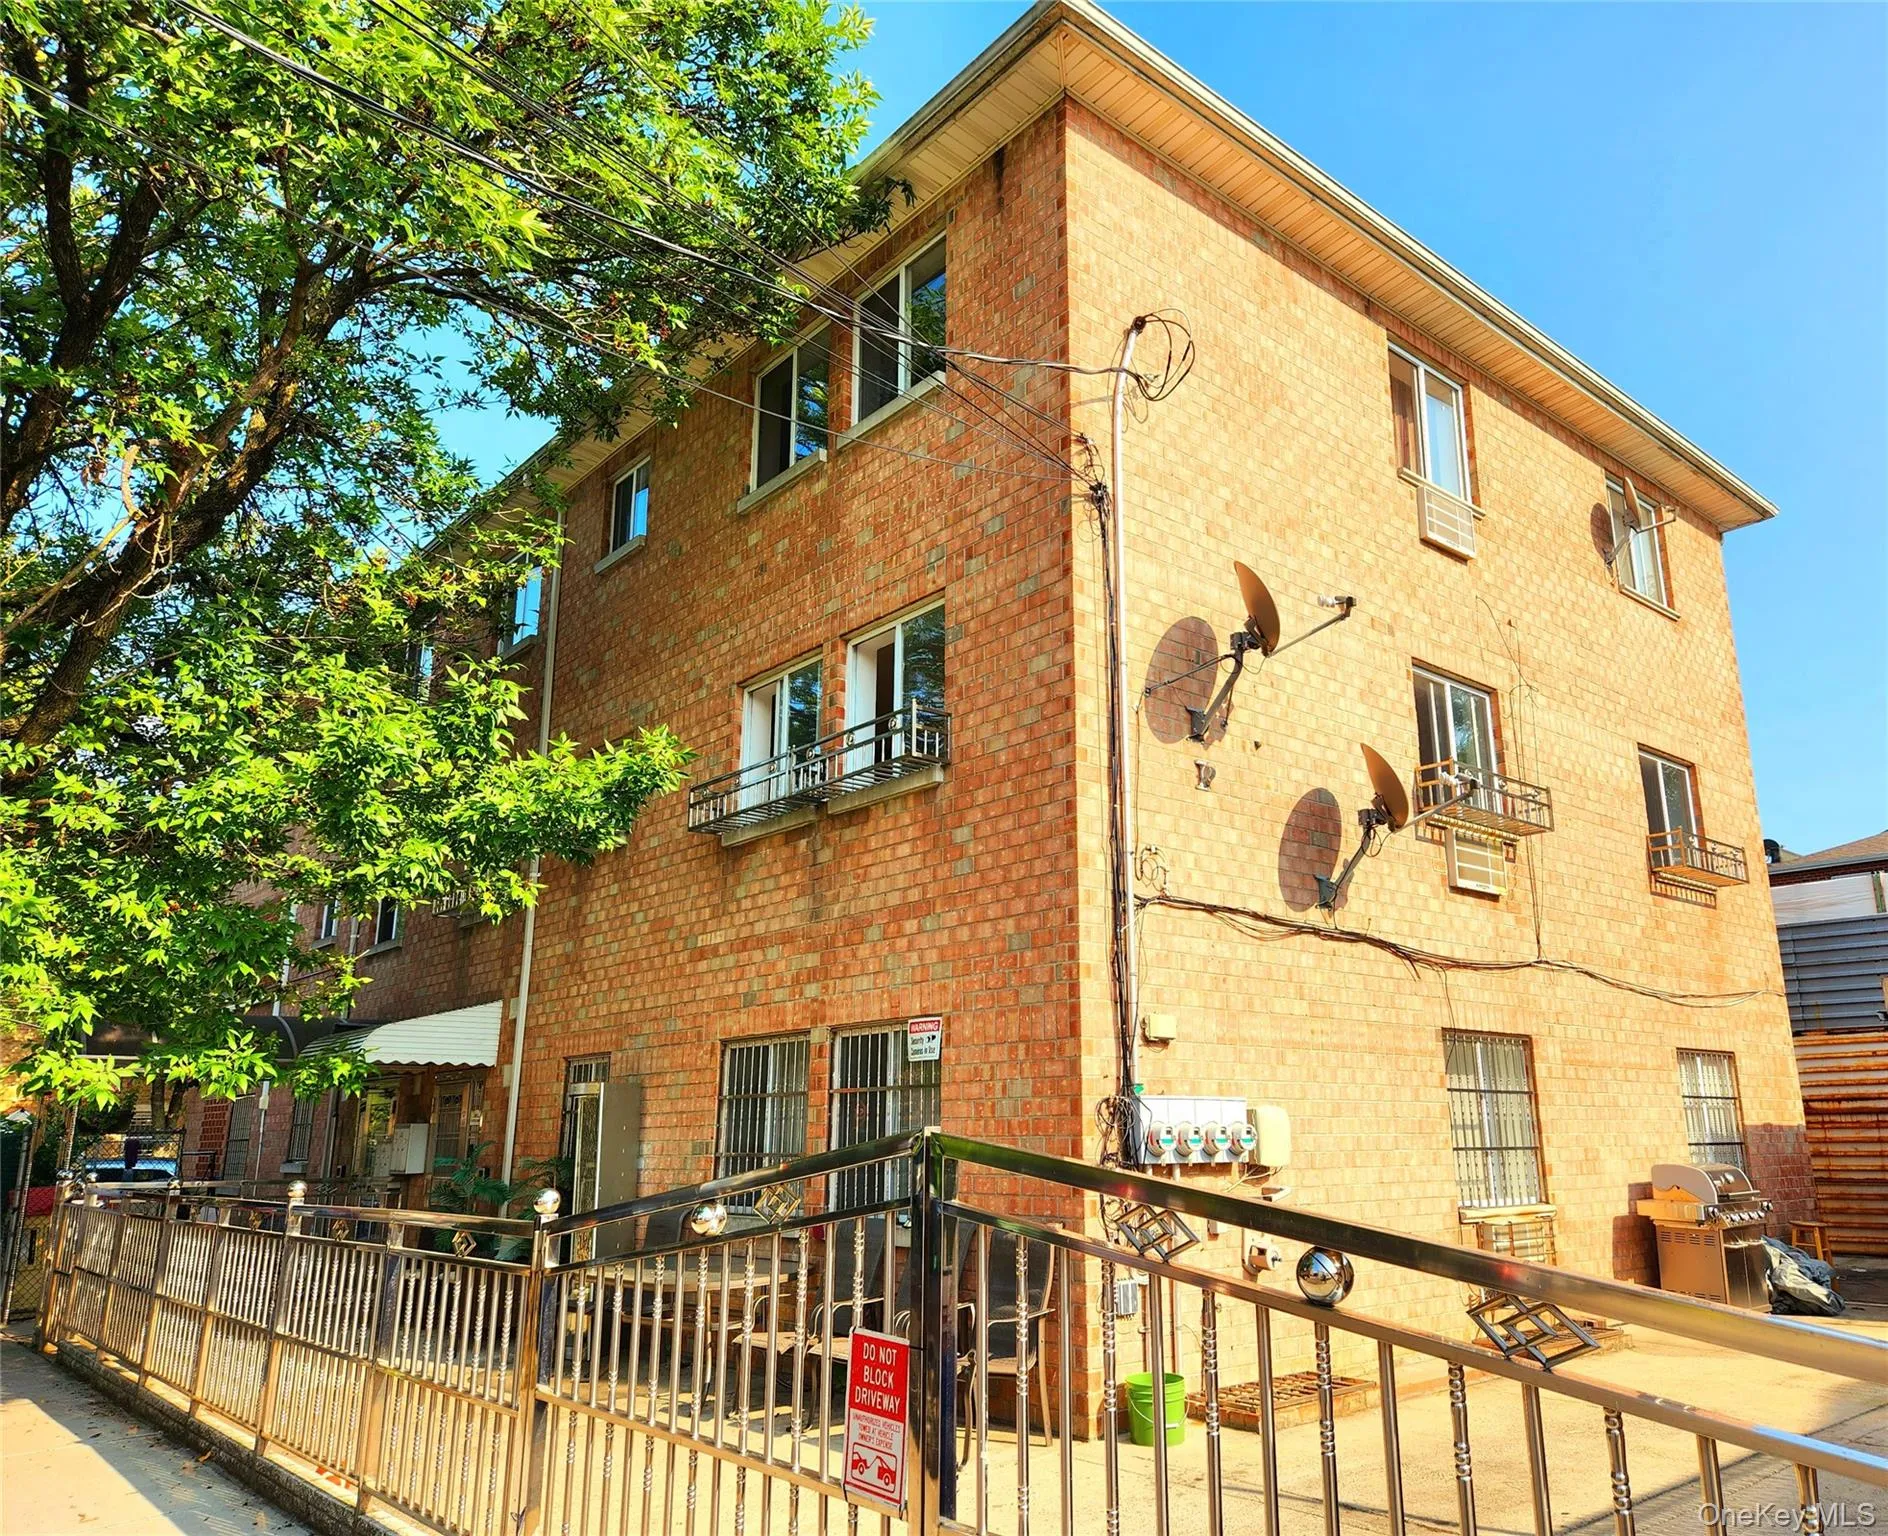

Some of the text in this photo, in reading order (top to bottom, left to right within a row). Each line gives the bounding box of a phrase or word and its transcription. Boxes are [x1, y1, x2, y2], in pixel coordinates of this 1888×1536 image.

[910, 1021, 939, 1033] WARNING
[863, 1342, 897, 1366] DO NOT
[863, 1365, 894, 1390] BLOCK
[855, 1386, 900, 1414] DRIVEWAY
